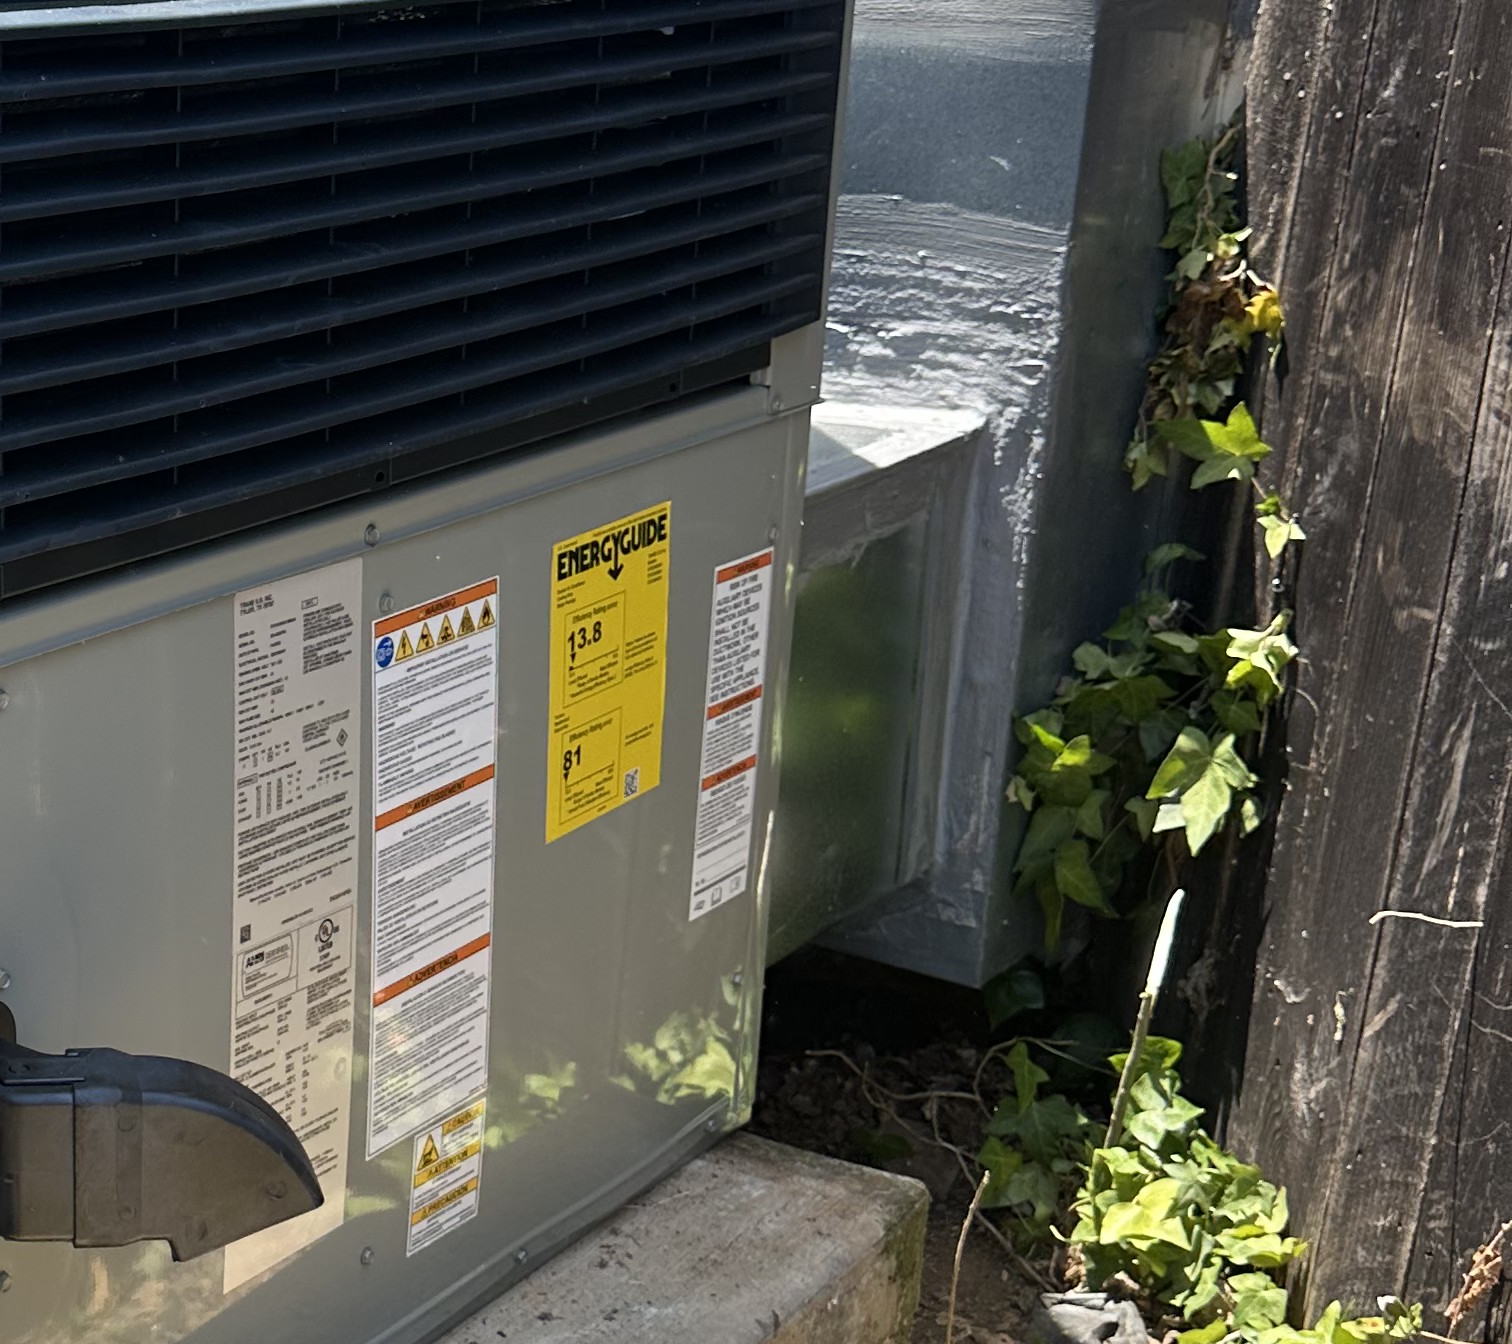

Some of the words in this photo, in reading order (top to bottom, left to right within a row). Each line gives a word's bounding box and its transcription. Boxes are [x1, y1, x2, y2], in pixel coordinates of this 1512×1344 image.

[557, 513, 668, 582] ENERGYGUIDE
[424, 596, 456, 617] WARNING
[567, 620, 602, 653] 13.8
[562, 744, 581, 771] 81
[413, 779, 465, 812] AVERTISSEMENT
[414, 952, 458, 983] ADVERTENCIA
